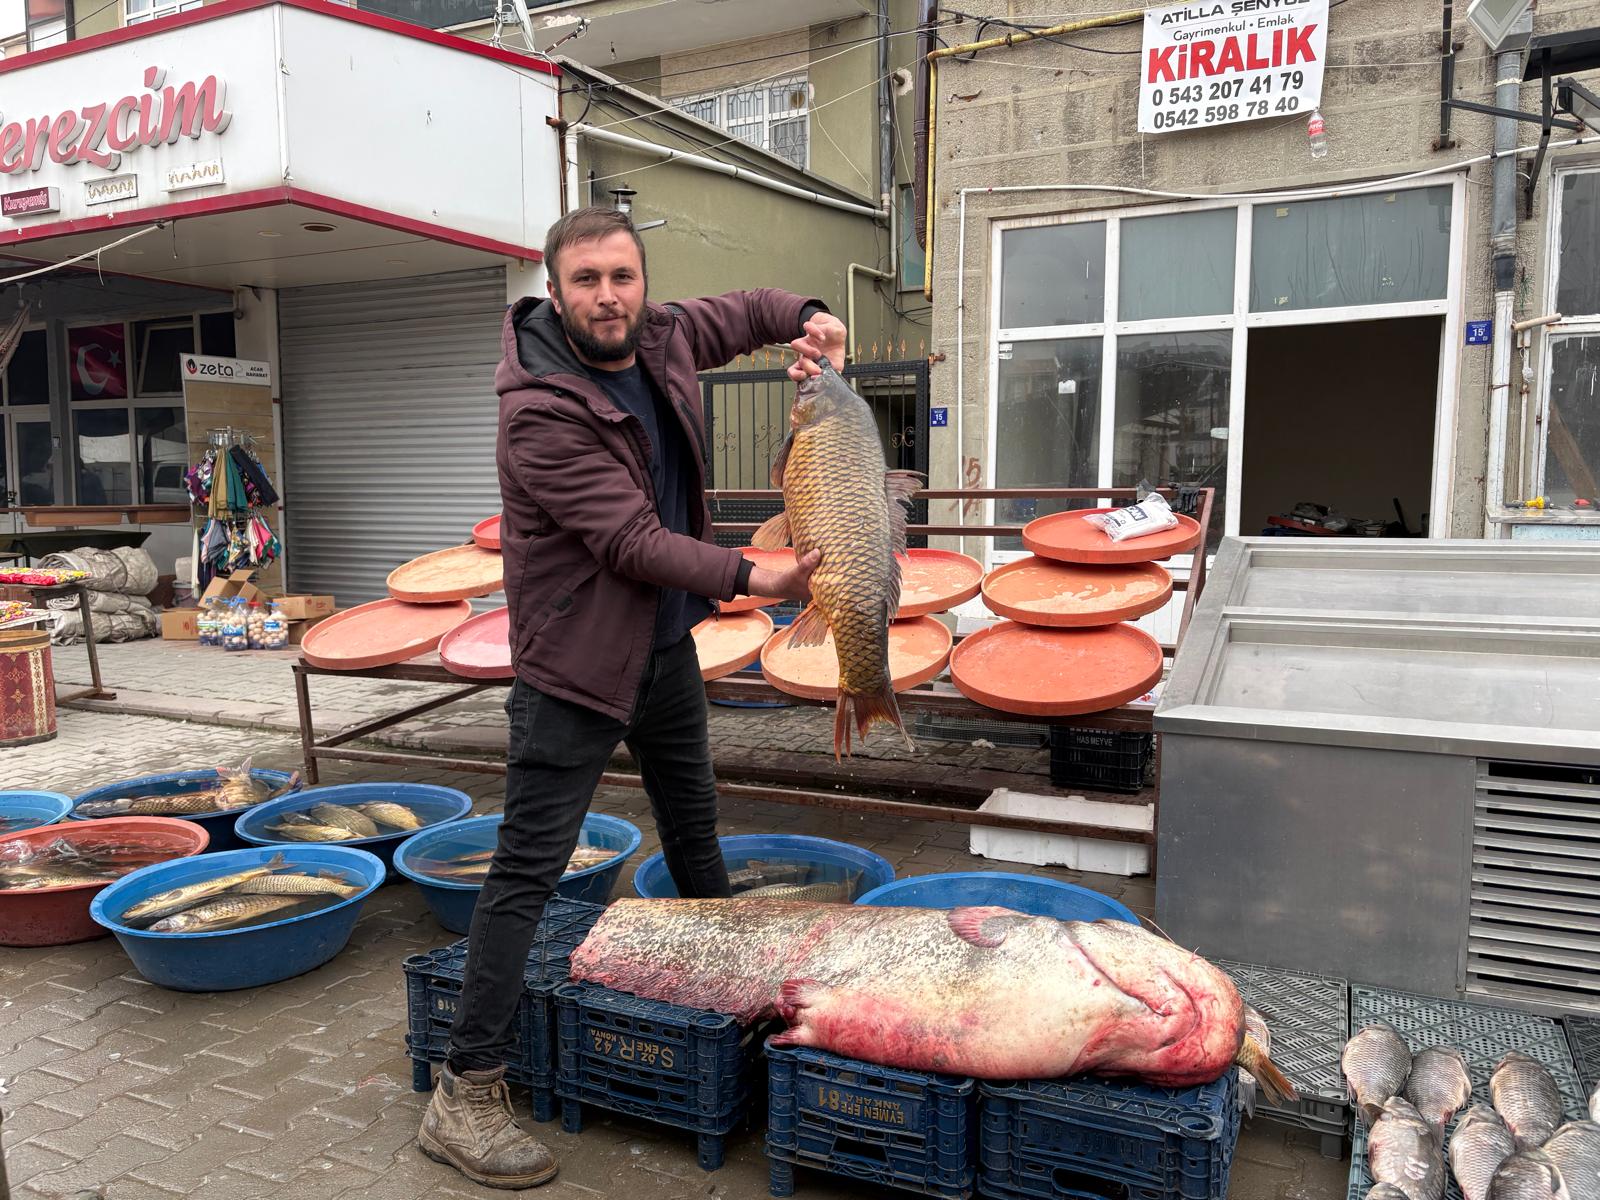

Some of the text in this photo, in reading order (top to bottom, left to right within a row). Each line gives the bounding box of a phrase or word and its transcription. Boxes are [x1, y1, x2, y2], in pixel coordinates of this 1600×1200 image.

[1161, 5, 1224, 25] ATİLLA
[1173, 14, 1294, 41] Gayrimenkul Emlak
[1152, 70, 1304, 106] 0 543 207 41 79
[0, 65, 228, 174] erezcim
[1153, 96, 1299, 129] 0542 598 78 40
[200, 362, 234, 377] zeta
[935, 413, 943, 421] 15
[1076, 735, 1113, 747] HAS MEYVE
[590, 1028, 617, 1042] KONYA
[594, 1036, 613, 1056] 42
[641, 1052, 656, 1065] ÖZ
[818, 1087, 904, 1124] EYMEN EFE 81
[845, 1092, 900, 1110] ANKARA
